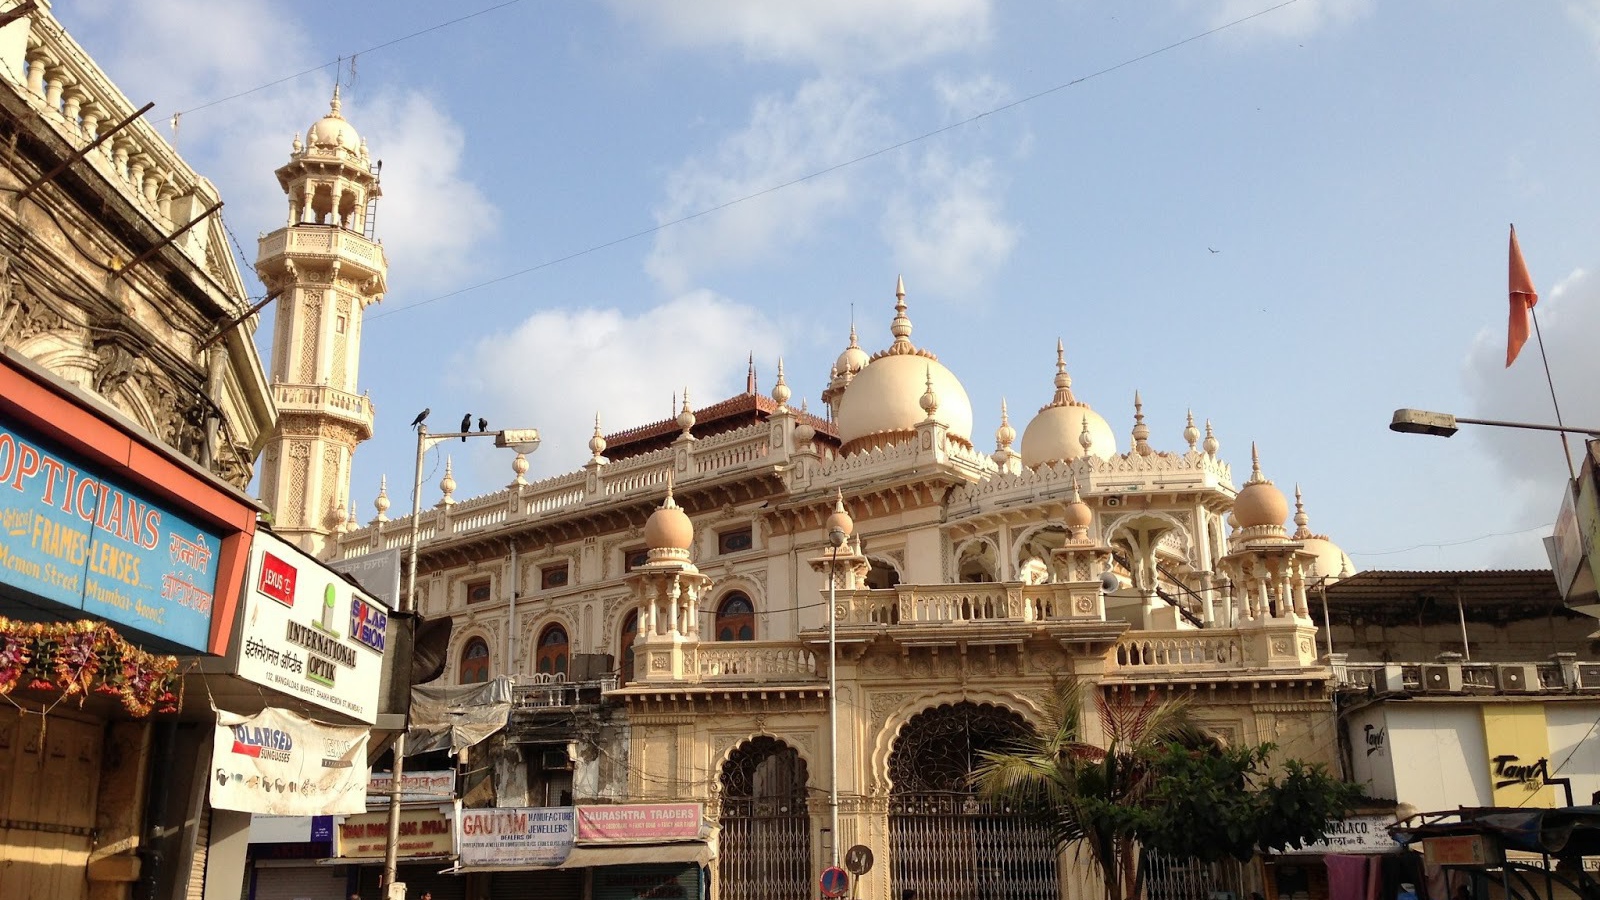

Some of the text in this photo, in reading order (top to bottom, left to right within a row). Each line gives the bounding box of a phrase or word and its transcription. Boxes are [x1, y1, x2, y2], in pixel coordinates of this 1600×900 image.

[0, 432, 161, 550] OPTICIANS
[32, 514, 88, 566] FRAMES
[265, 568, 283, 590] LEXUS
[287, 619, 357, 668] INTERNATIONAL
[309, 656, 336, 681] OPTIK
[274, 674, 299, 691] MANGALDAS
[463, 813, 527, 835] GAUTAM
[583, 809, 694, 821] SAURASHTRA TRADERS
[528, 824, 568, 834] JEWELLERS
